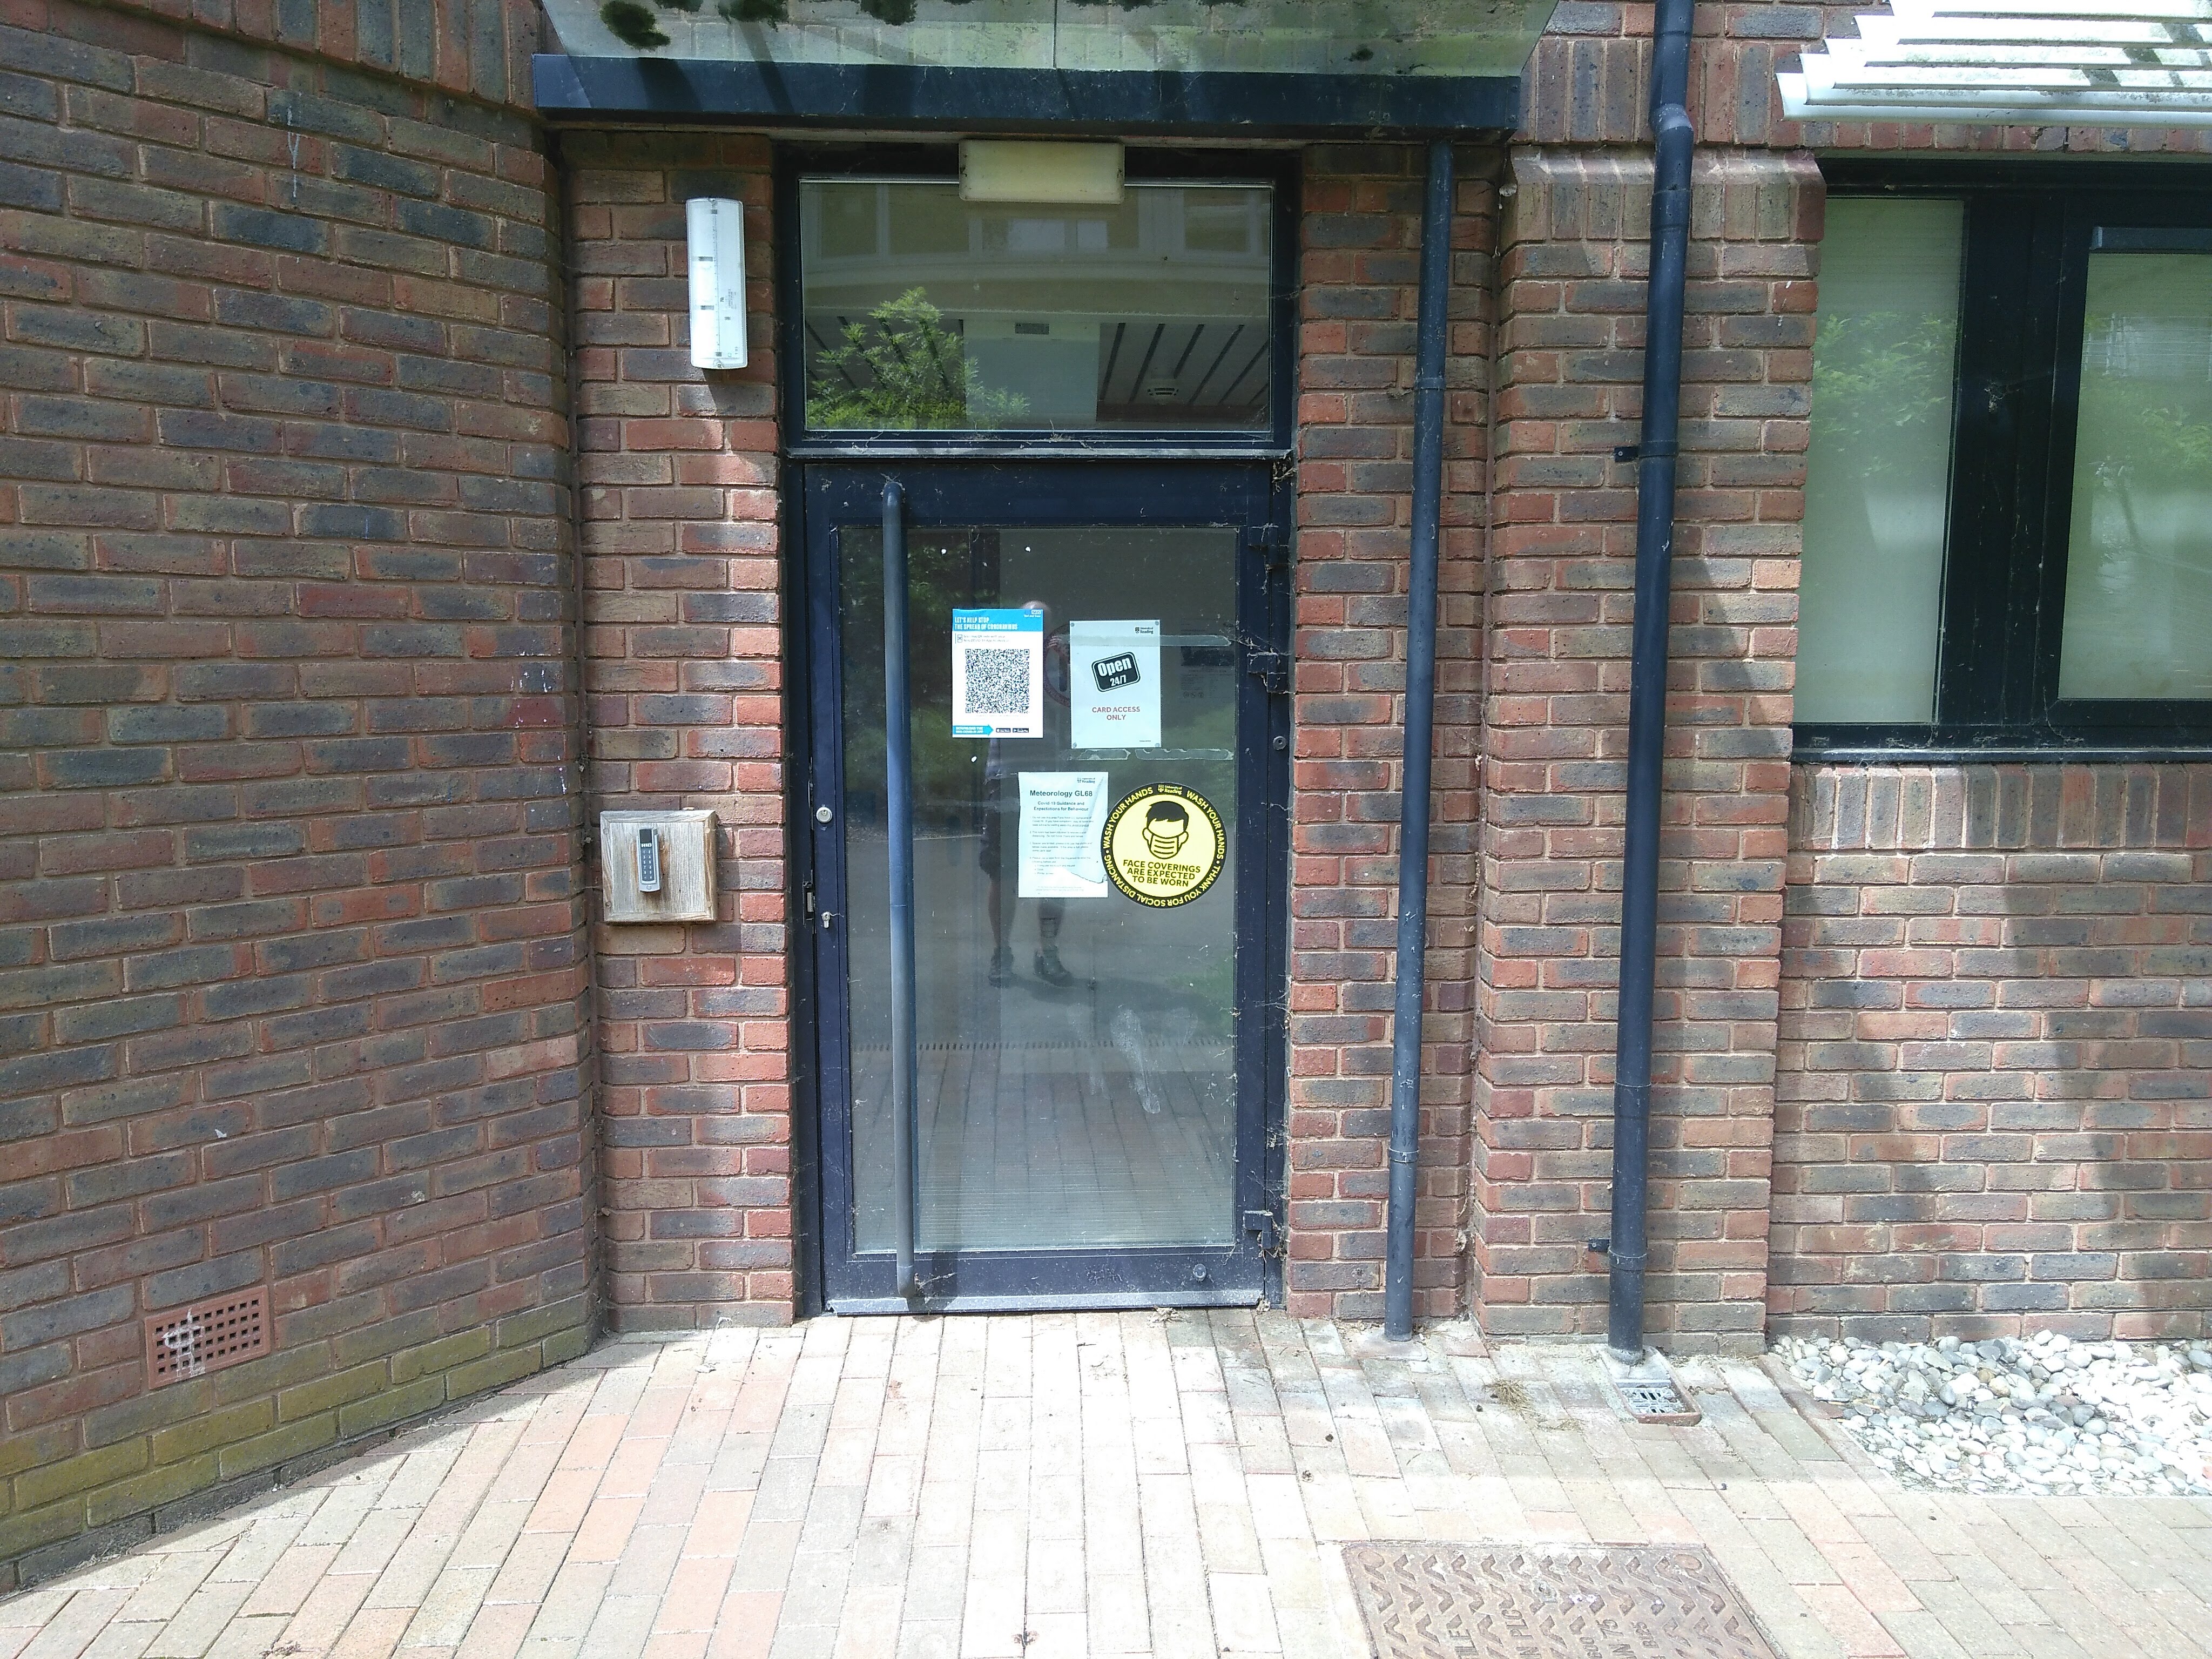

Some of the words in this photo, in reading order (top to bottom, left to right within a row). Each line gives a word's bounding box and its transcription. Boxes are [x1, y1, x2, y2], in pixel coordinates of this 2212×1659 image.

[1097, 658, 1132, 677] Open
[1110, 675, 1127, 686] 24/7
[1103, 824, 1114, 849] WASH
[1109, 803, 1127, 823] YOUR
[1124, 787, 1154, 806] HANDS
[1186, 790, 1209, 810] WASH
[1206, 806, 1221, 830] YOUR
[1216, 830, 1225, 860] HANDS
[1123, 859, 1145, 868] FACE
[1148, 861, 1201, 873] COVERINGS
[1127, 867, 1145, 875] ARE
[1147, 869, 1195, 880] EXPECTED
[1104, 854, 1136, 898] DISTANCING
[1132, 875, 1145, 883] TO
[1147, 876, 1158, 885] BE
[1160, 878, 1189, 887] WORN
[1199, 866, 1220, 891] THANK
[1136, 893, 1166, 907] SOCIAL
[1167, 896, 1184, 906] FOR
[1184, 888, 1202, 902] YOU
[1501, 1609, 1534, 1640] PLC
[1595, 1620, 1624, 1639] 75
